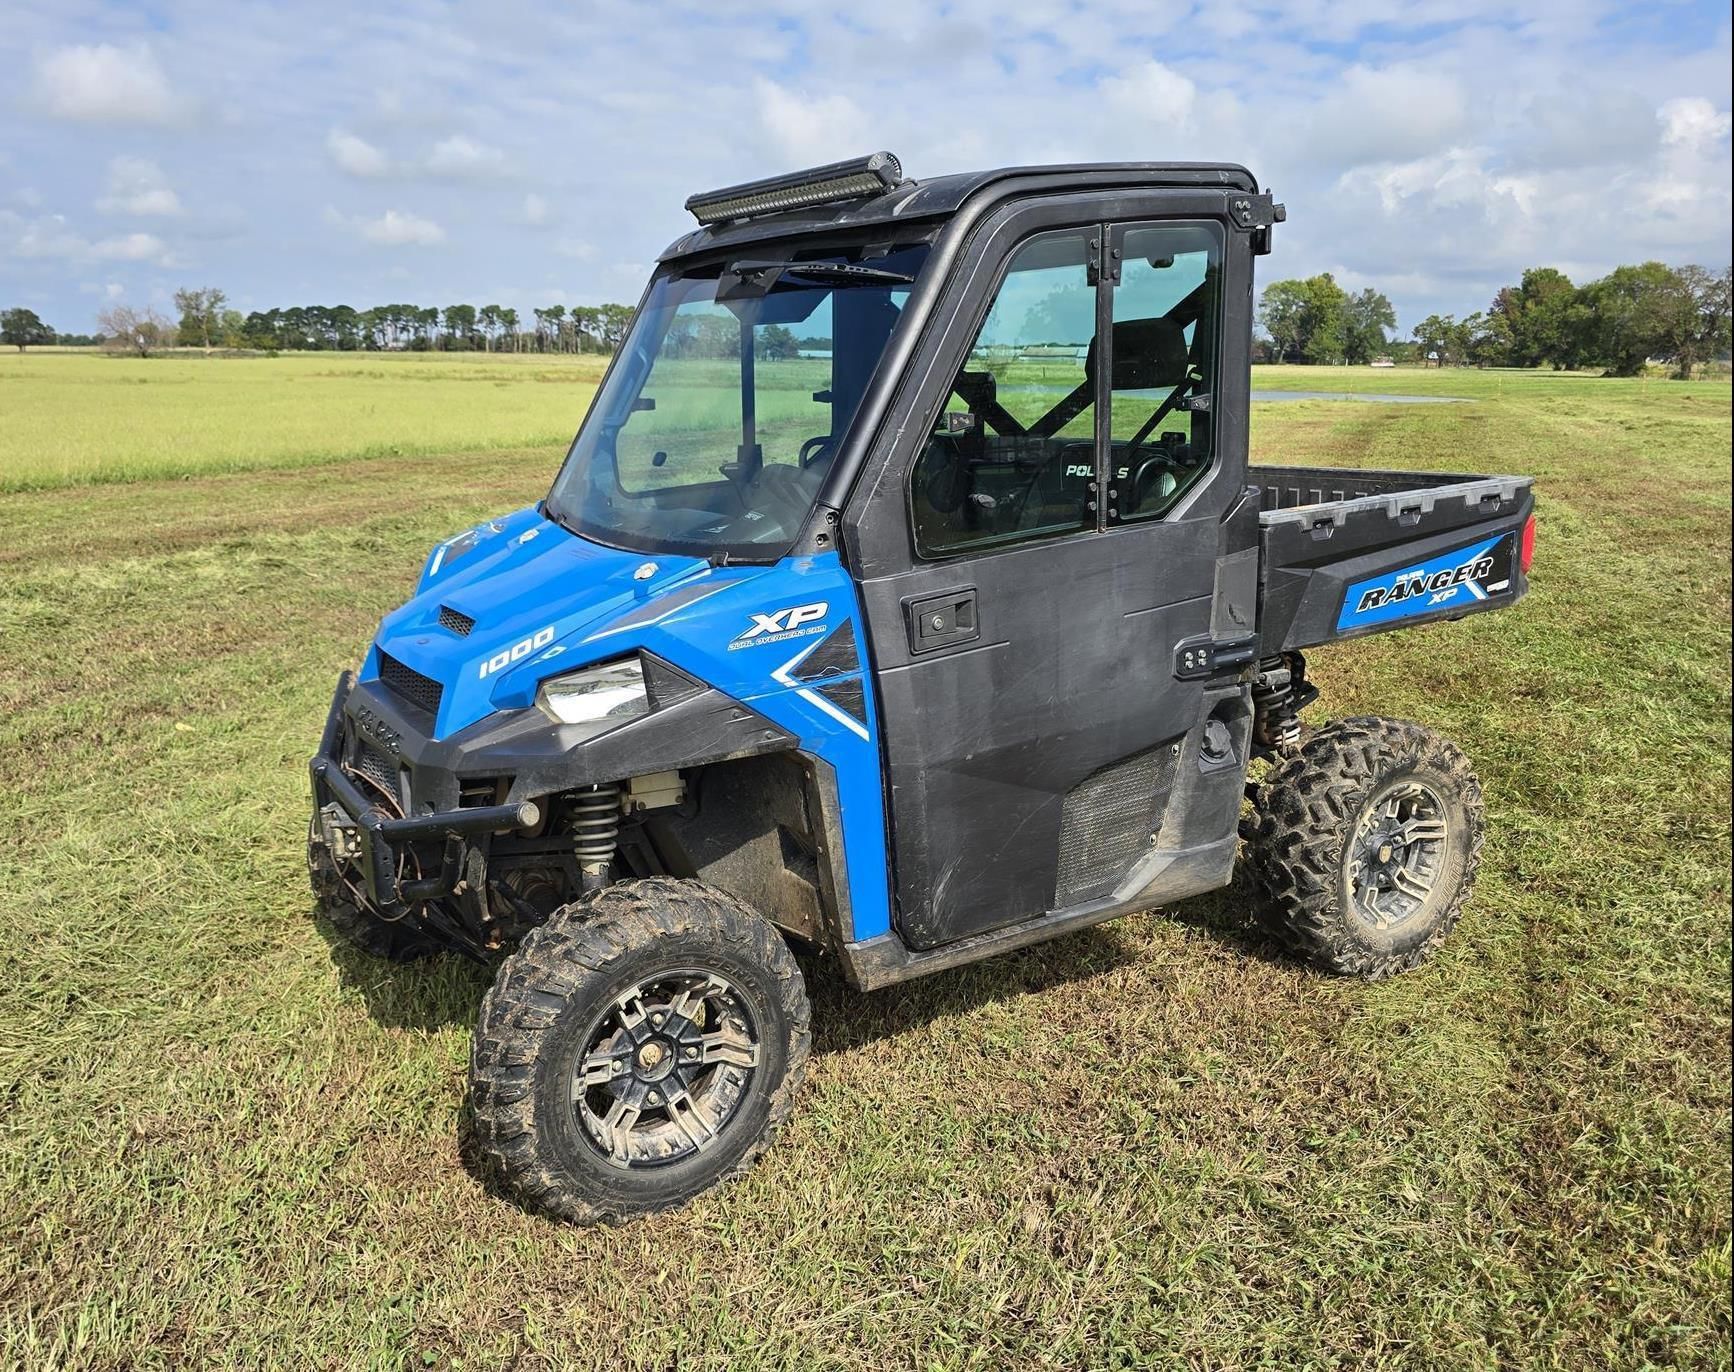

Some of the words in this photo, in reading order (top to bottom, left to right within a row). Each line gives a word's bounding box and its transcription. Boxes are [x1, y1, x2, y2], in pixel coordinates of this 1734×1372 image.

[1066, 465, 1129, 479] POLS
[1356, 557, 1493, 613] RANGER
[1427, 588, 1458, 606] XP
[739, 601, 829, 640] XP
[479, 626, 554, 679] 1000
